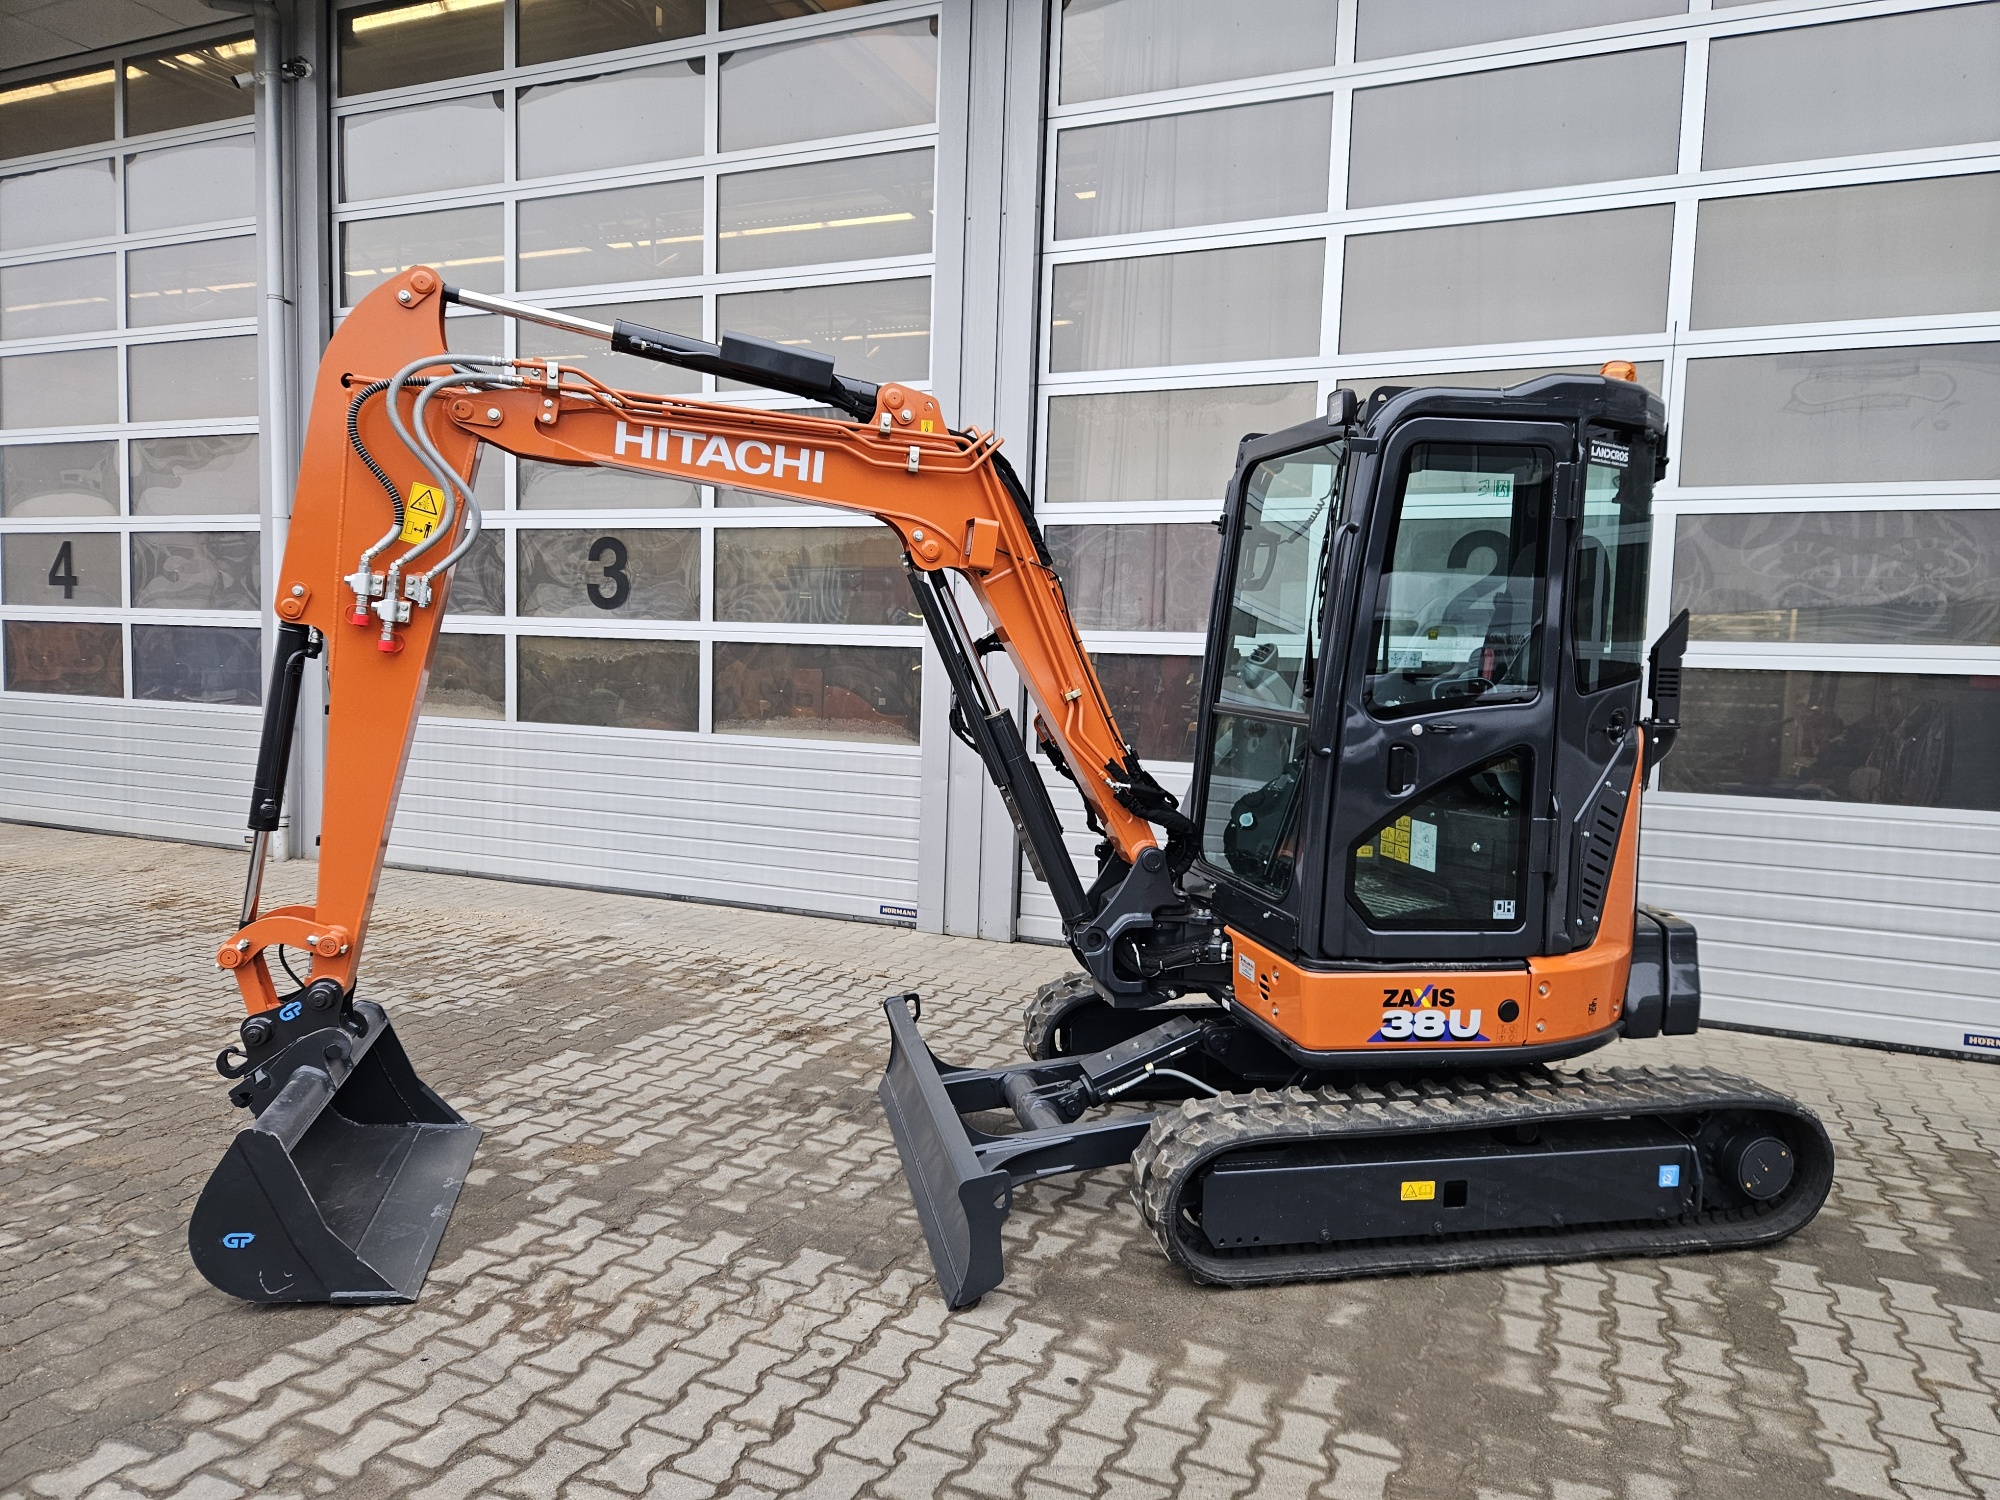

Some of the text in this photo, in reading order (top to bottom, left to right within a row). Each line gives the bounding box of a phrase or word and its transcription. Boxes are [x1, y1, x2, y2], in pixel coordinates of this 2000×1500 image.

[614, 420, 825, 484] HITACHI
[1591, 445, 1629, 462] LANDCROS
[48, 540, 78, 600] 4
[587, 536, 630, 611] 3
[1441, 529, 1511, 626] 2
[278, 1001, 303, 1022] GP
[1382, 984, 1456, 1008] ZAXIS
[1380, 1009, 1482, 1042] 38U
[222, 1232, 256, 1249] GP
